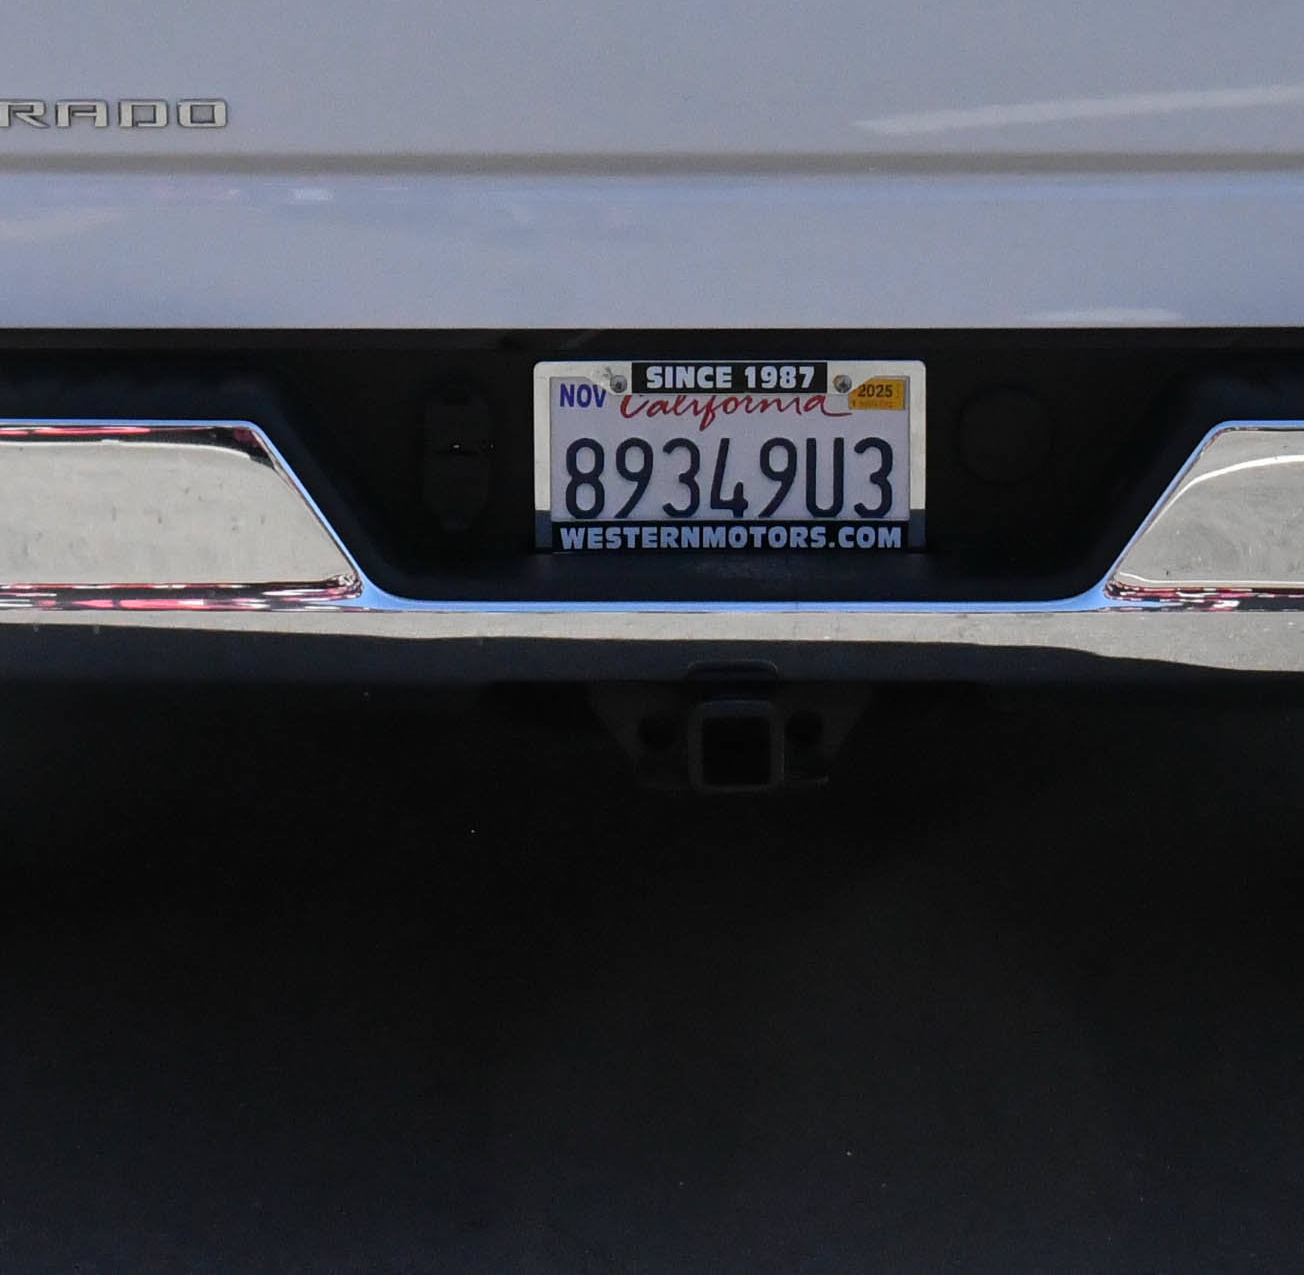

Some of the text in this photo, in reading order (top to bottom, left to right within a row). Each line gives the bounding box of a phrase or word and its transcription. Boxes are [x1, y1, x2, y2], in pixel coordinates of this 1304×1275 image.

[646, 365, 815, 389] SINCE 1987
[559, 383, 607, 408] NOV
[857, 384, 893, 398] 2025
[619, 394, 853, 431] California
[564, 437, 895, 519] 89349U3
[560, 525, 902, 550] WESTERNMOTORS.COM
